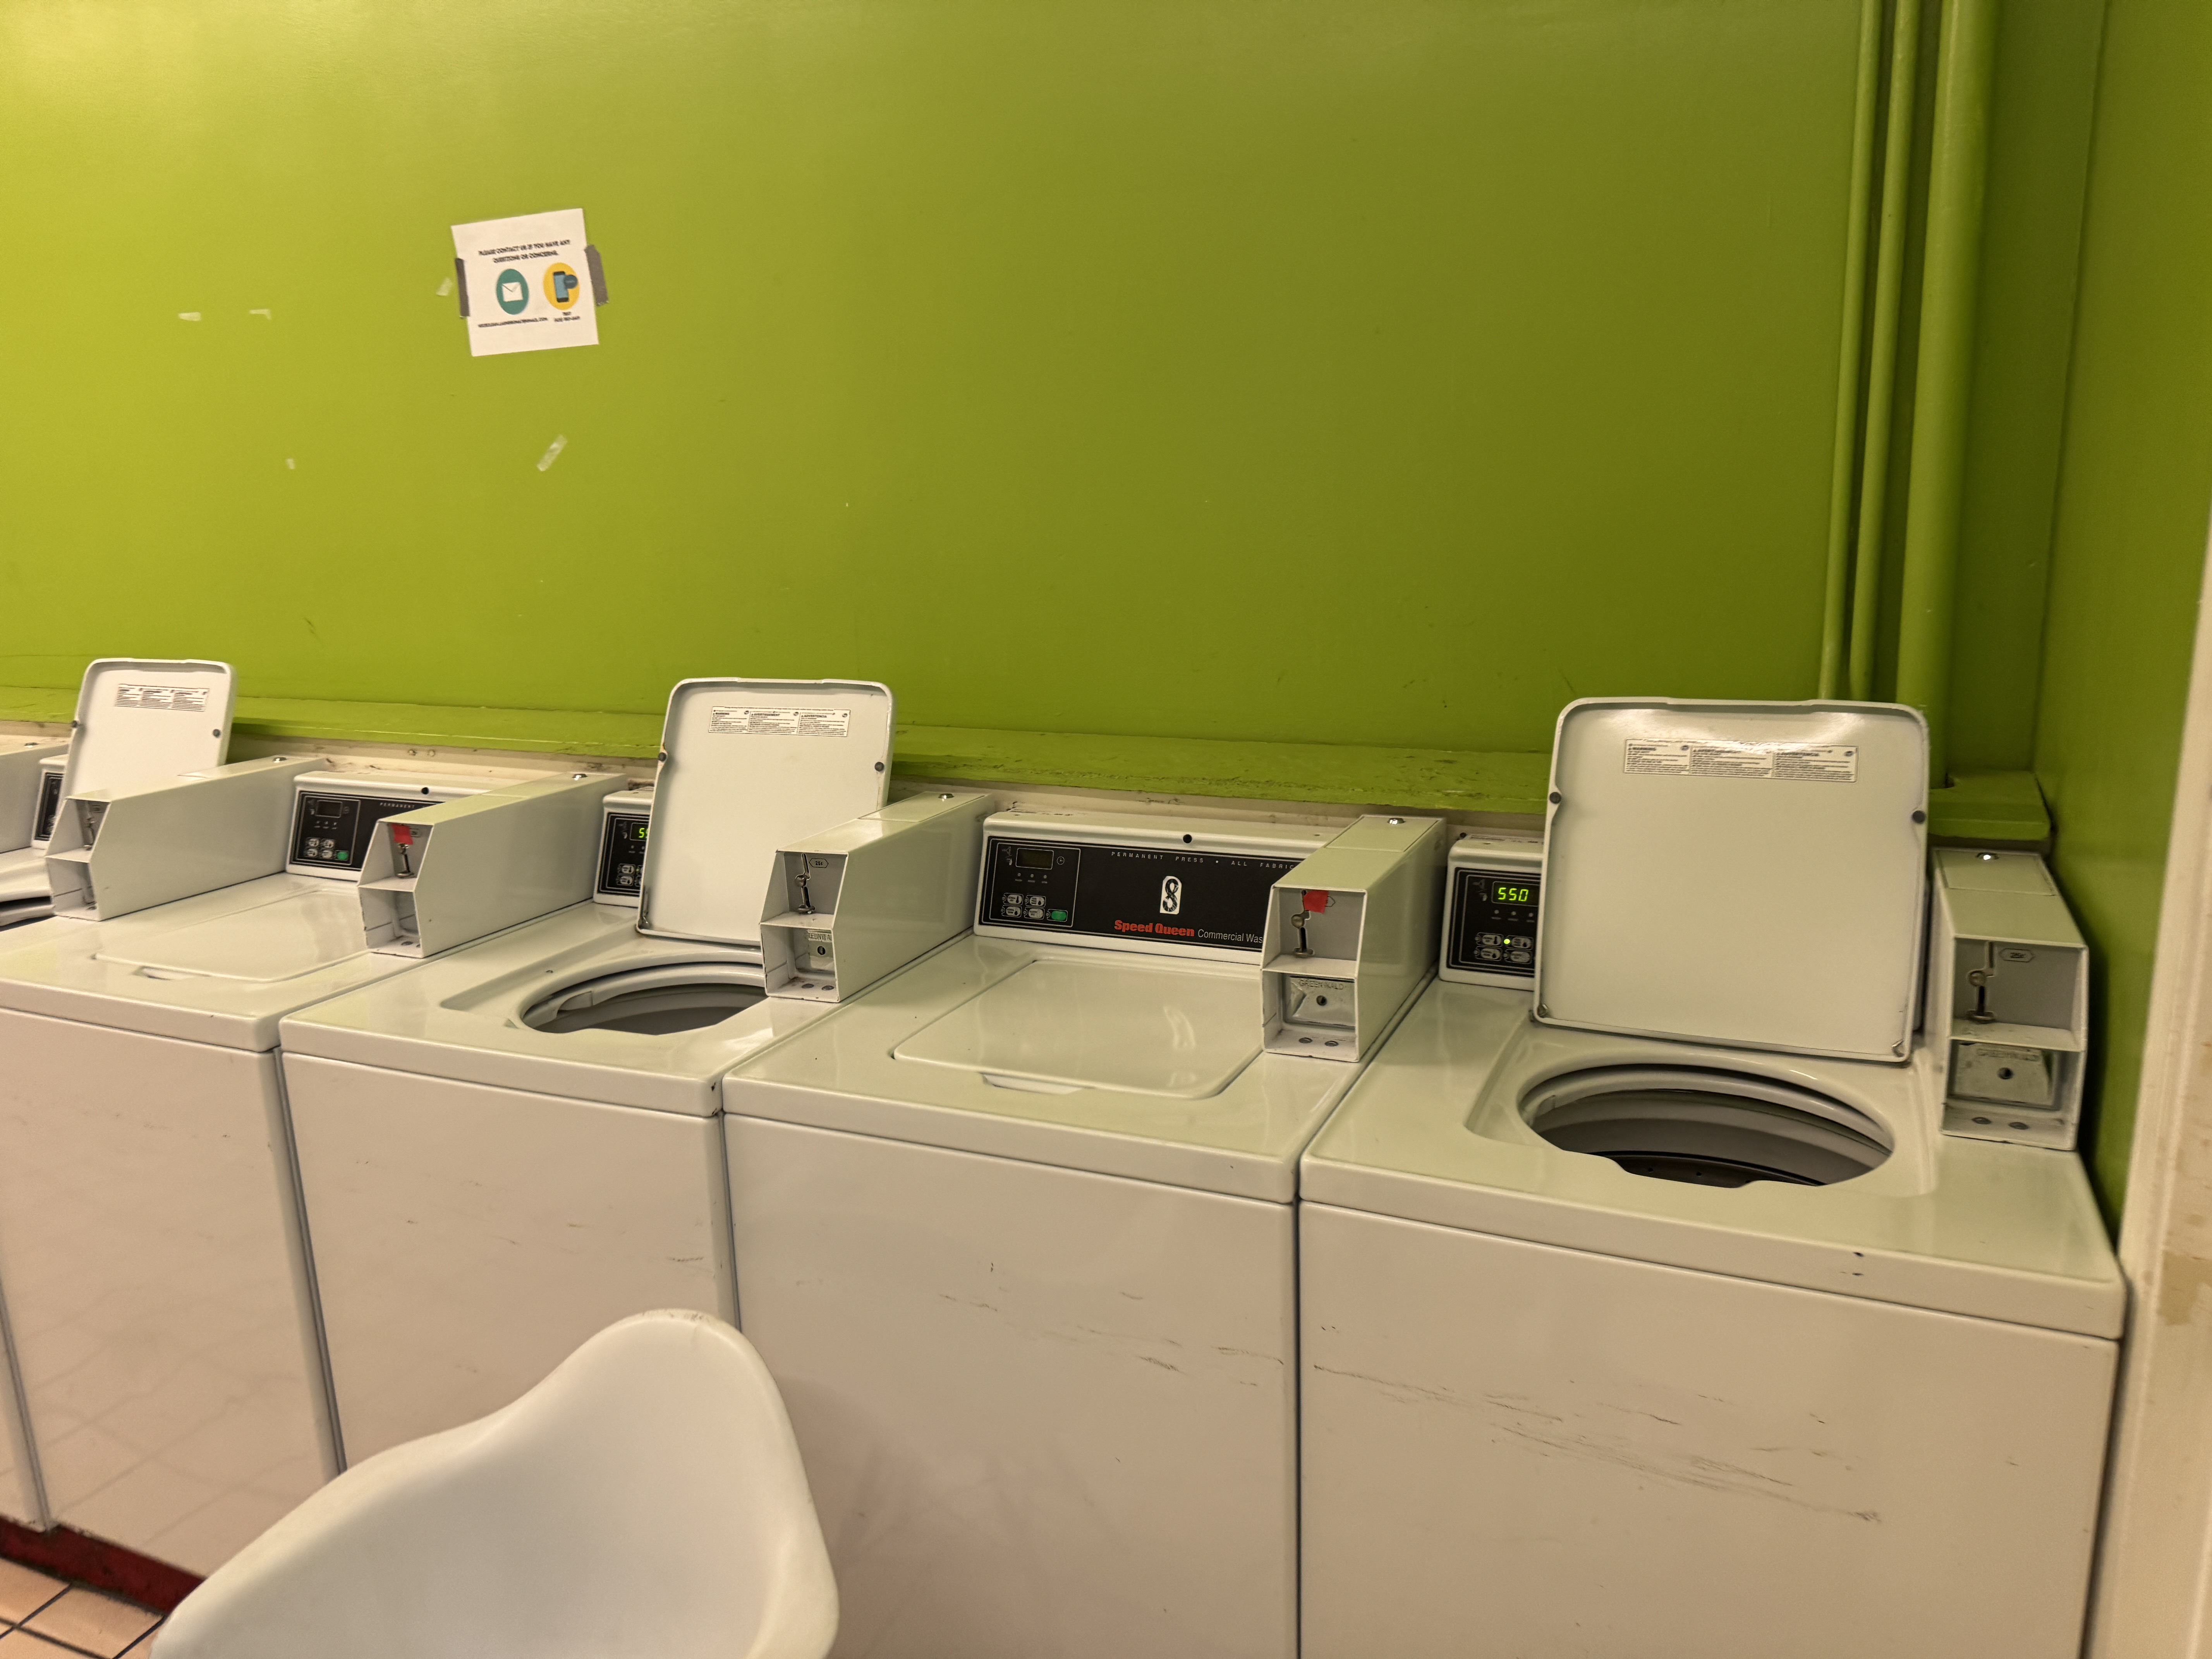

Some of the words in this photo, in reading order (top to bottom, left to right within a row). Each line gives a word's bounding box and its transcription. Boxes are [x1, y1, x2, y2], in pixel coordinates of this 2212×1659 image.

[1111, 852, 1163, 860] PERMANENT
[1498, 887, 1529, 902] 550
[1114, 919, 1153, 933] Speed
[1155, 923, 1195, 937] Queen
[1197, 929, 1244, 941] Commercial
